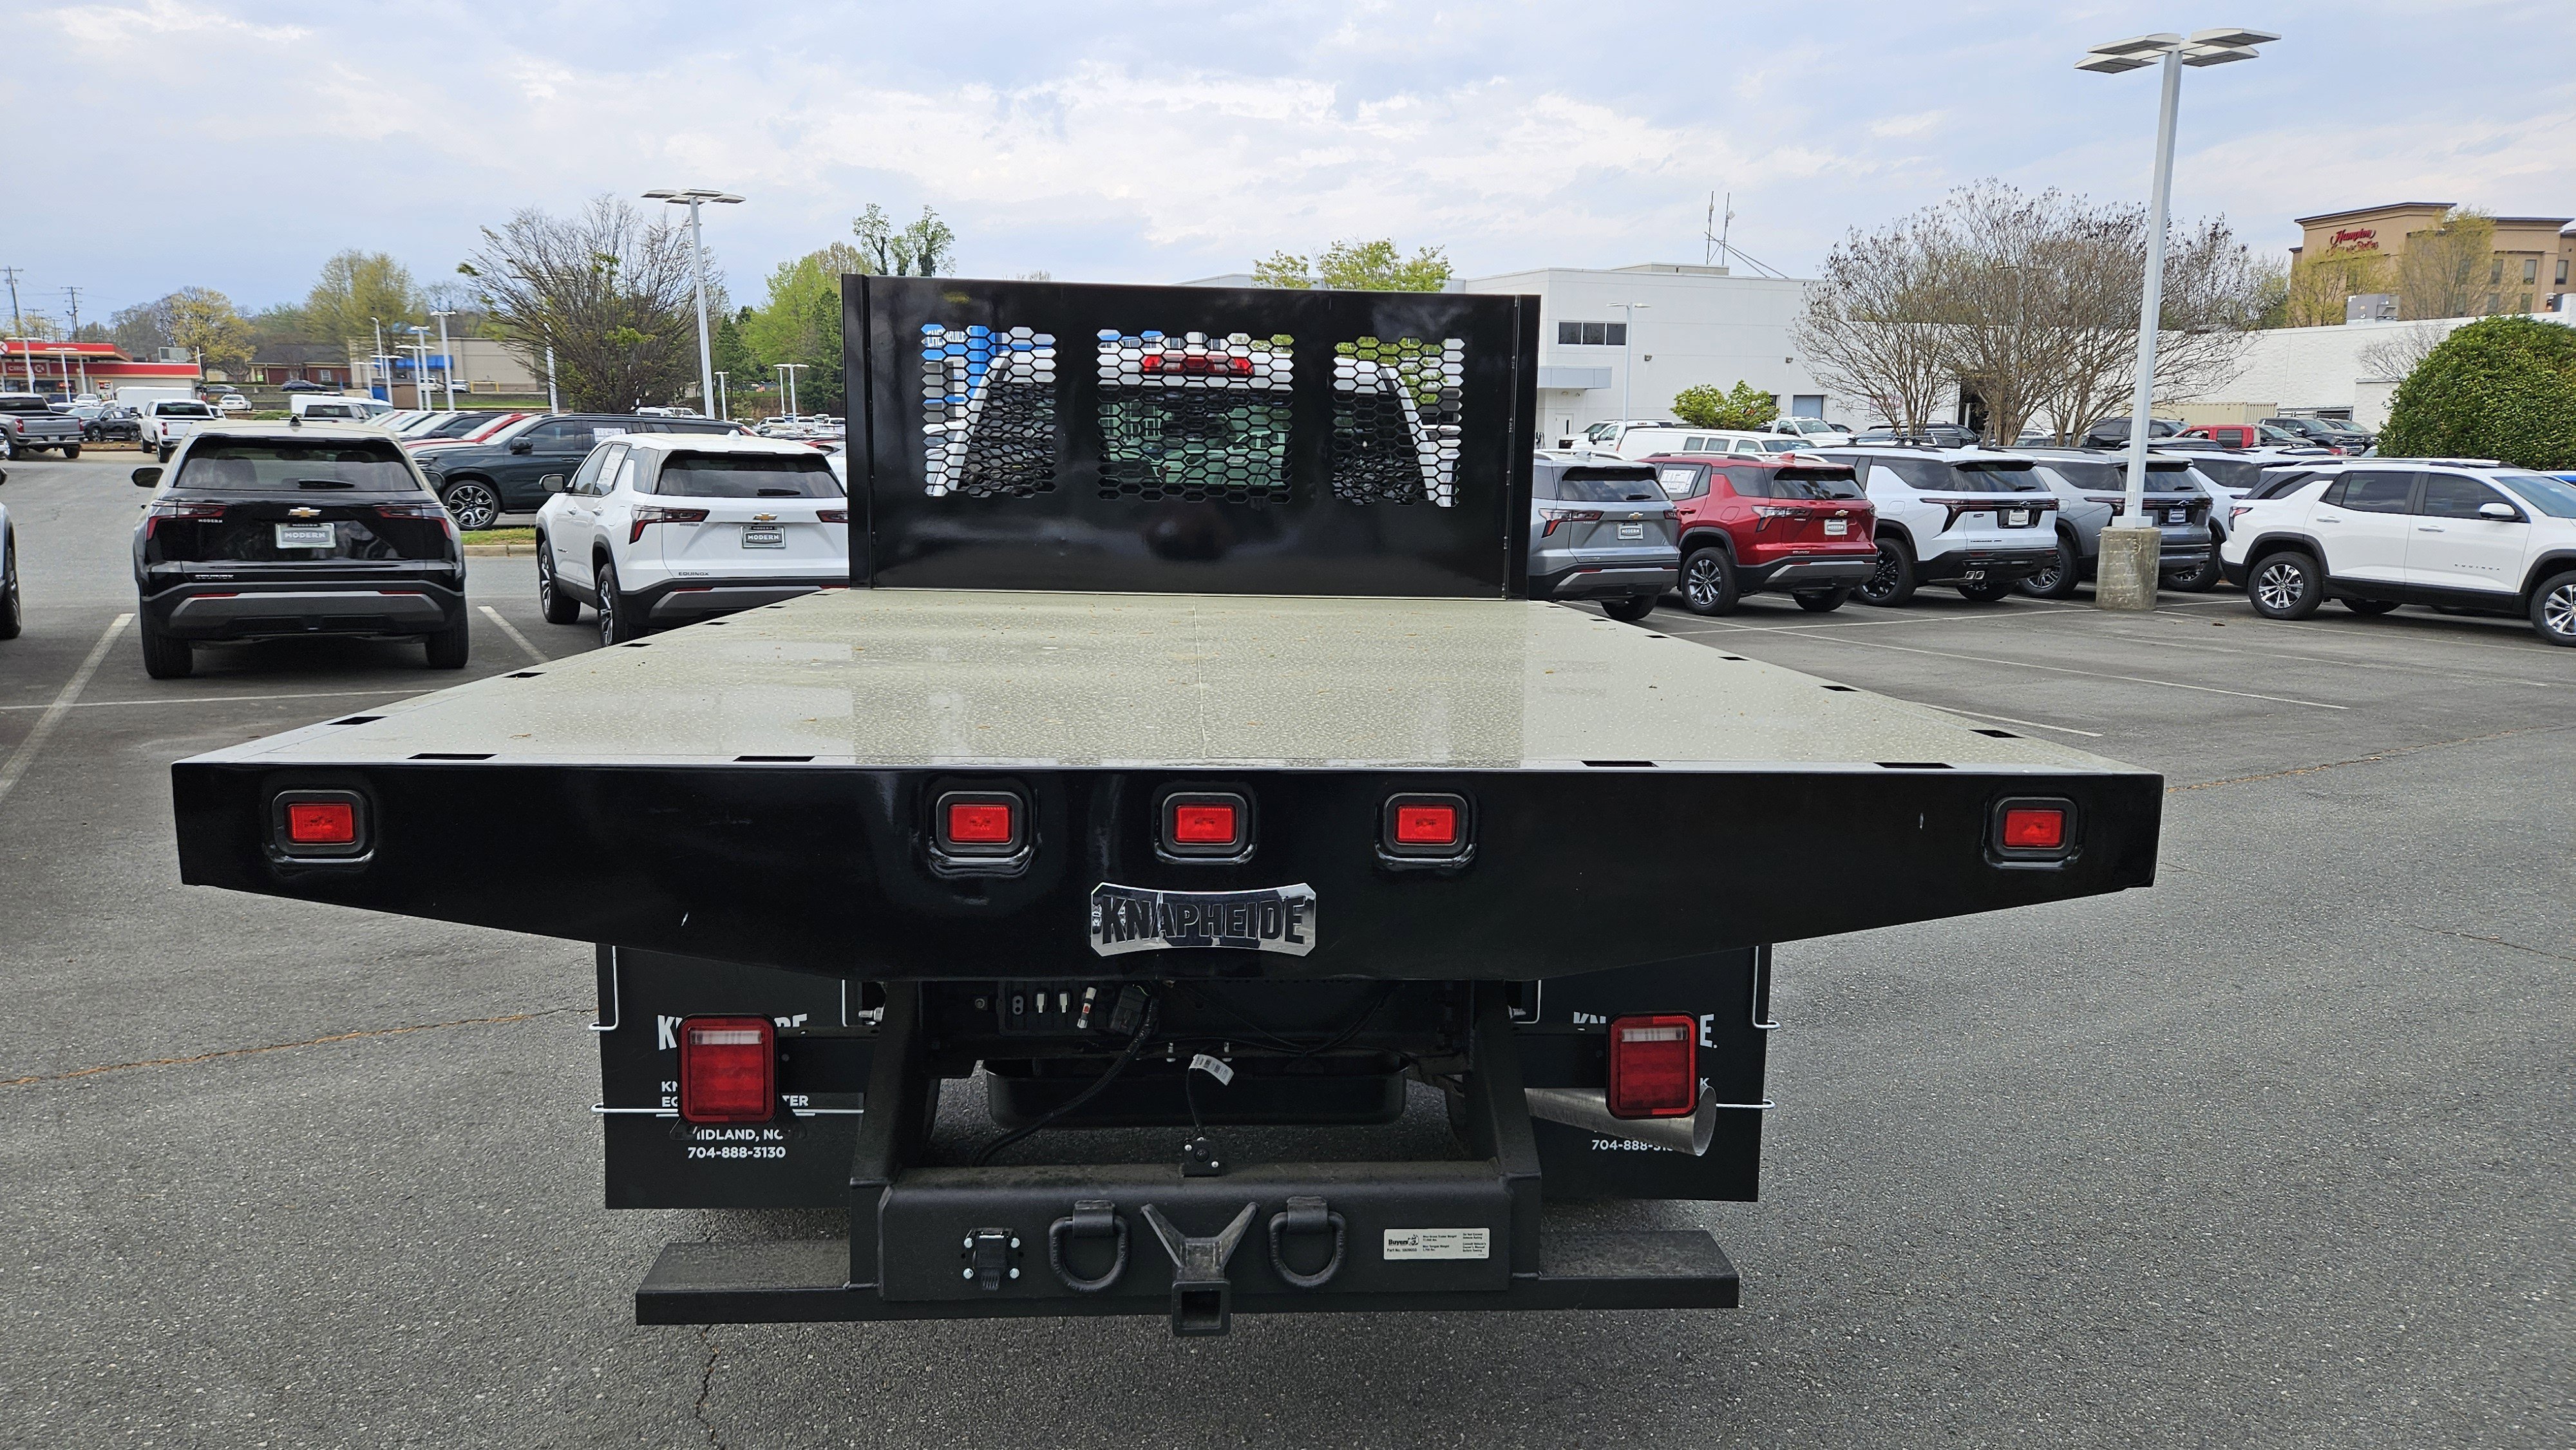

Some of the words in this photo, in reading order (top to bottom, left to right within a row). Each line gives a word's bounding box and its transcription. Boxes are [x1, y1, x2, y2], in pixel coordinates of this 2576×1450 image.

[2330, 228, 2376, 245] Hampton
[1102, 895, 1307, 945] KNAPHEIDE
[687, 1146, 787, 1159] 704-888-3130
